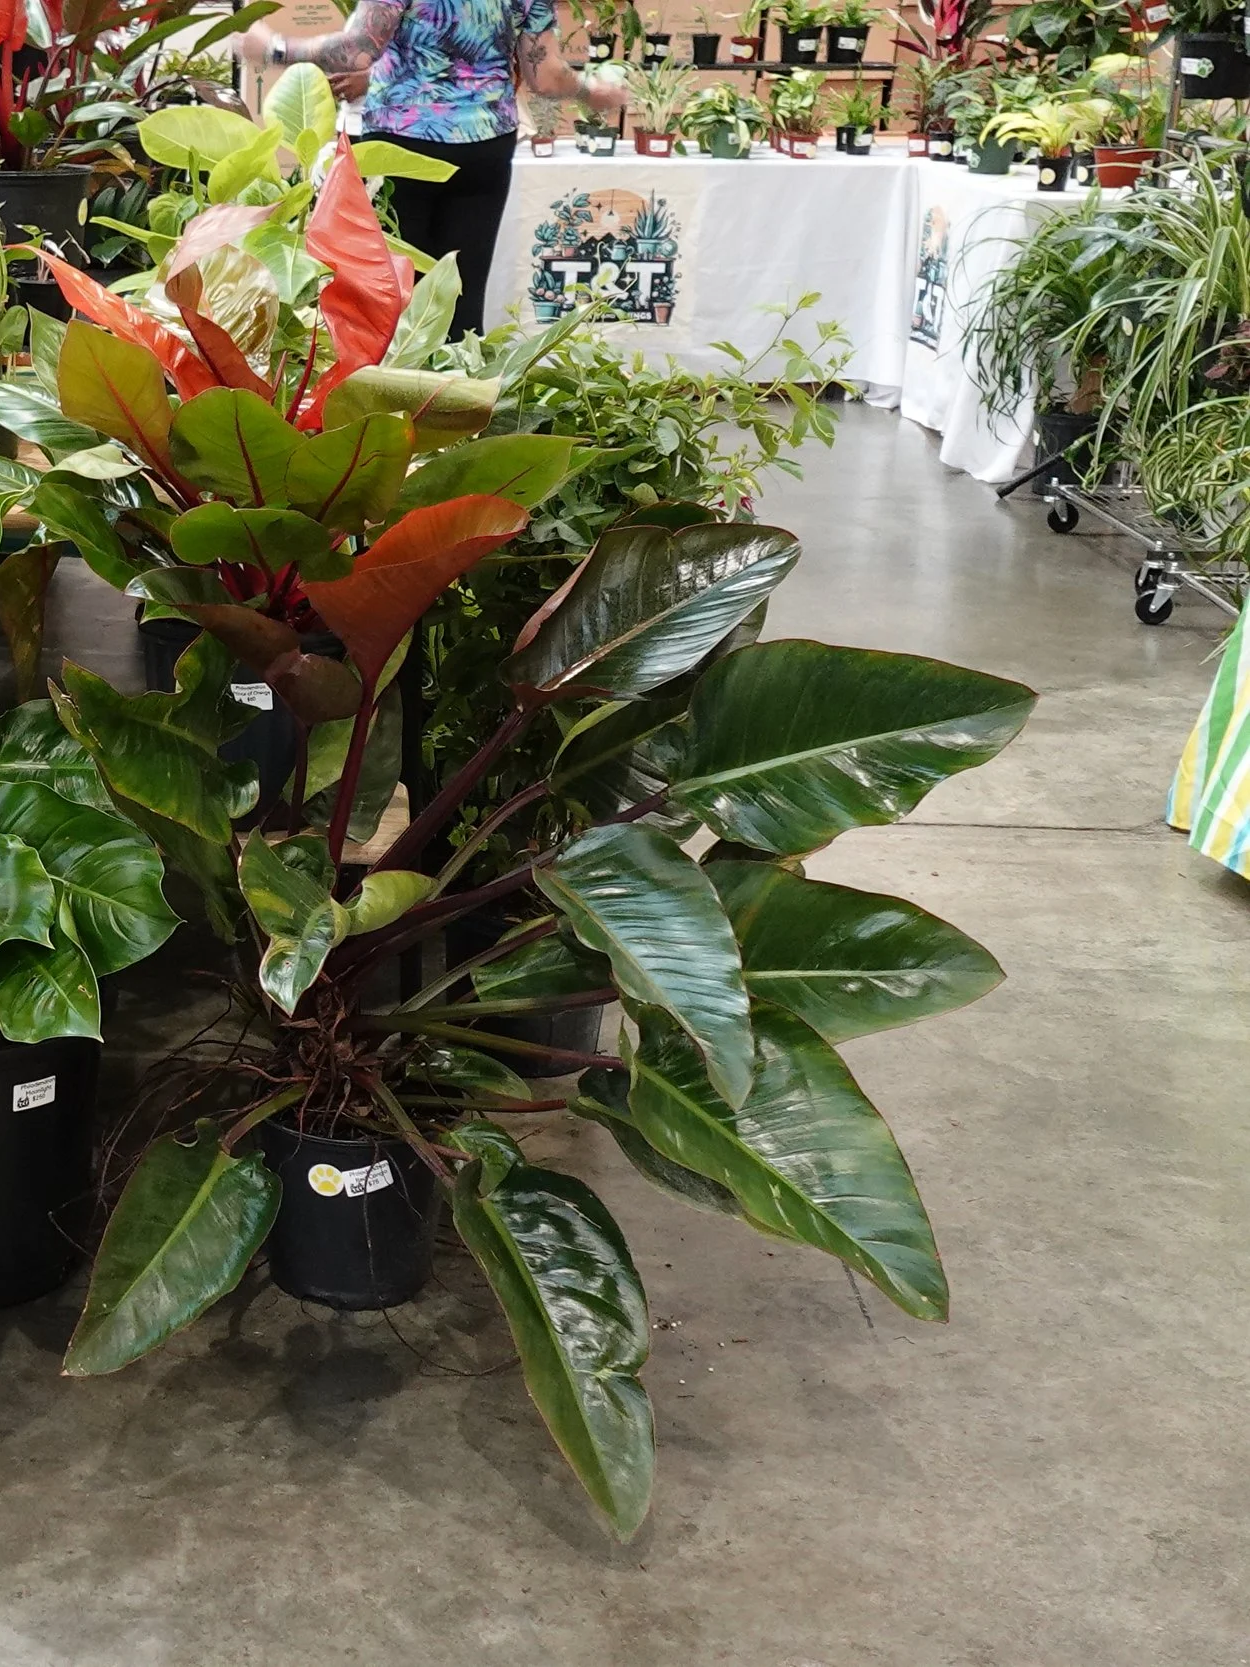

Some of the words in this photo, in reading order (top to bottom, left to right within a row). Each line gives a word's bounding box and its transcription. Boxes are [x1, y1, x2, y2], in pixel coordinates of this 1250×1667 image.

[551, 261, 667, 306] T&T
[913, 277, 945, 333] T&T
[20, 1077, 56, 1090] Philodendron
[26, 1084, 52, 1096] Moonlight
